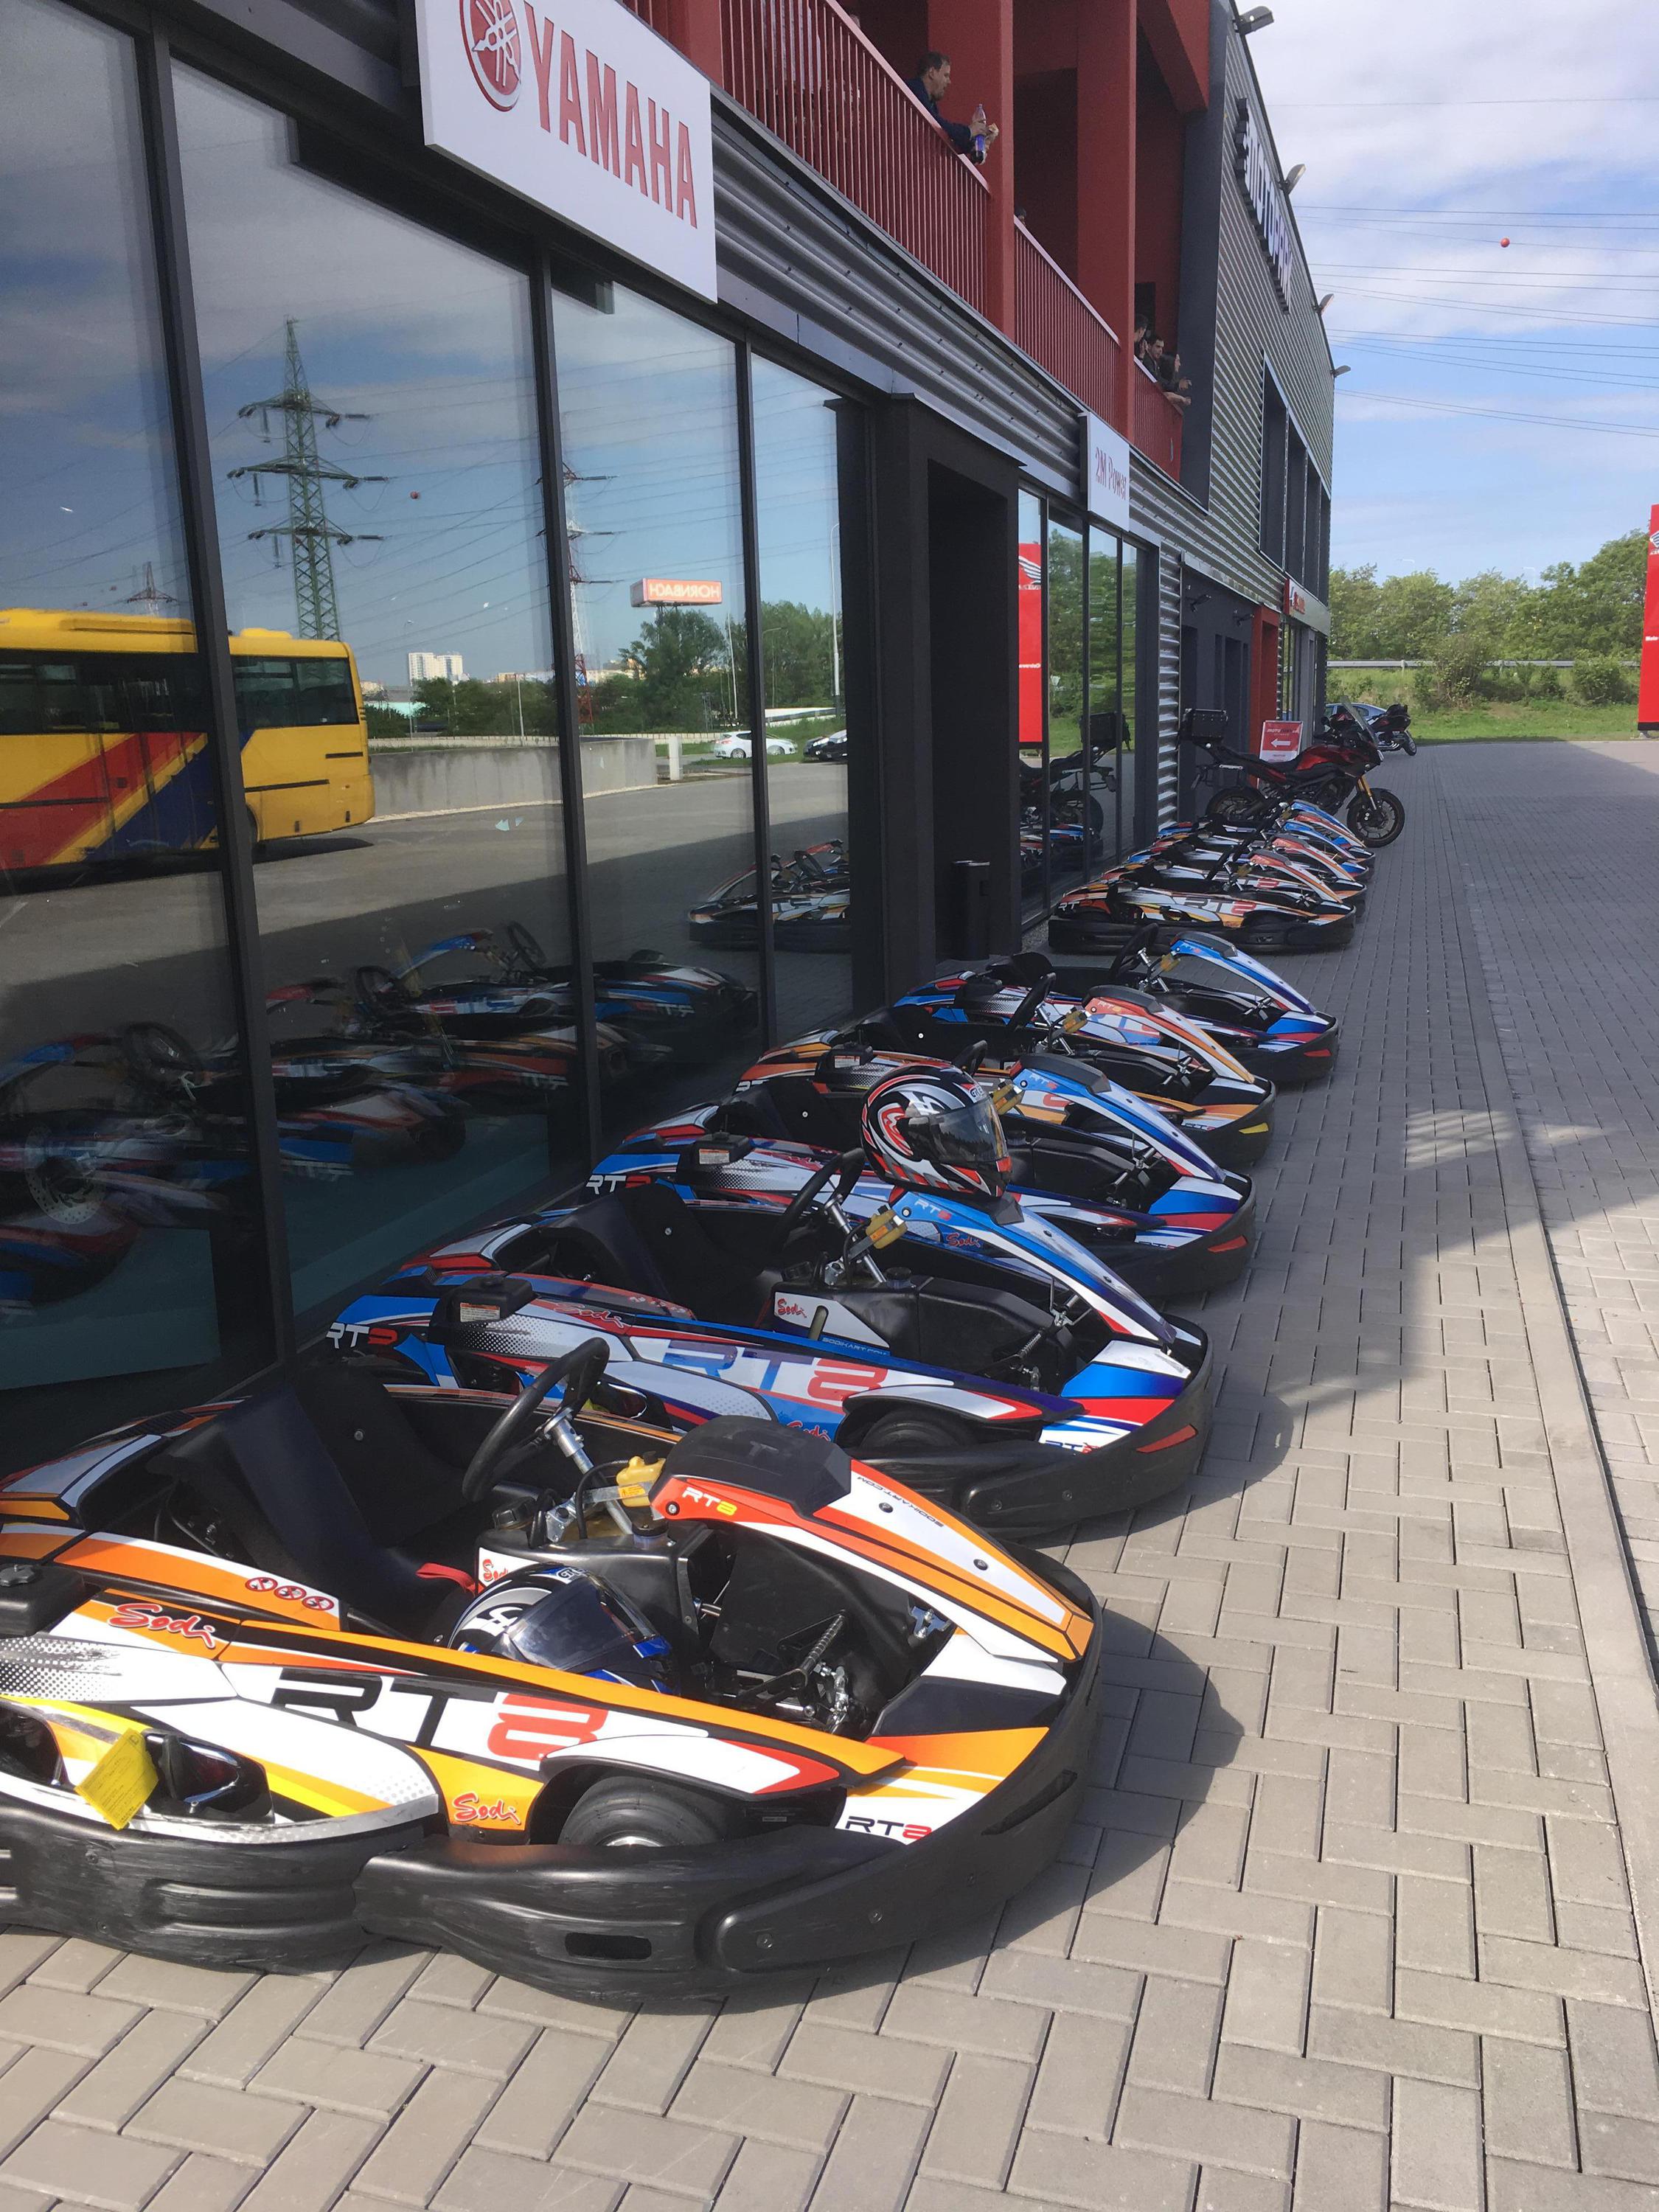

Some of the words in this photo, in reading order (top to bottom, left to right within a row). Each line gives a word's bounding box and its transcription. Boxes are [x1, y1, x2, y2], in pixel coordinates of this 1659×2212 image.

[524, 0, 698, 229] YAMAHA
[108, 1603, 216, 1649] Sodi
[452, 1792, 522, 1825] Sodi
